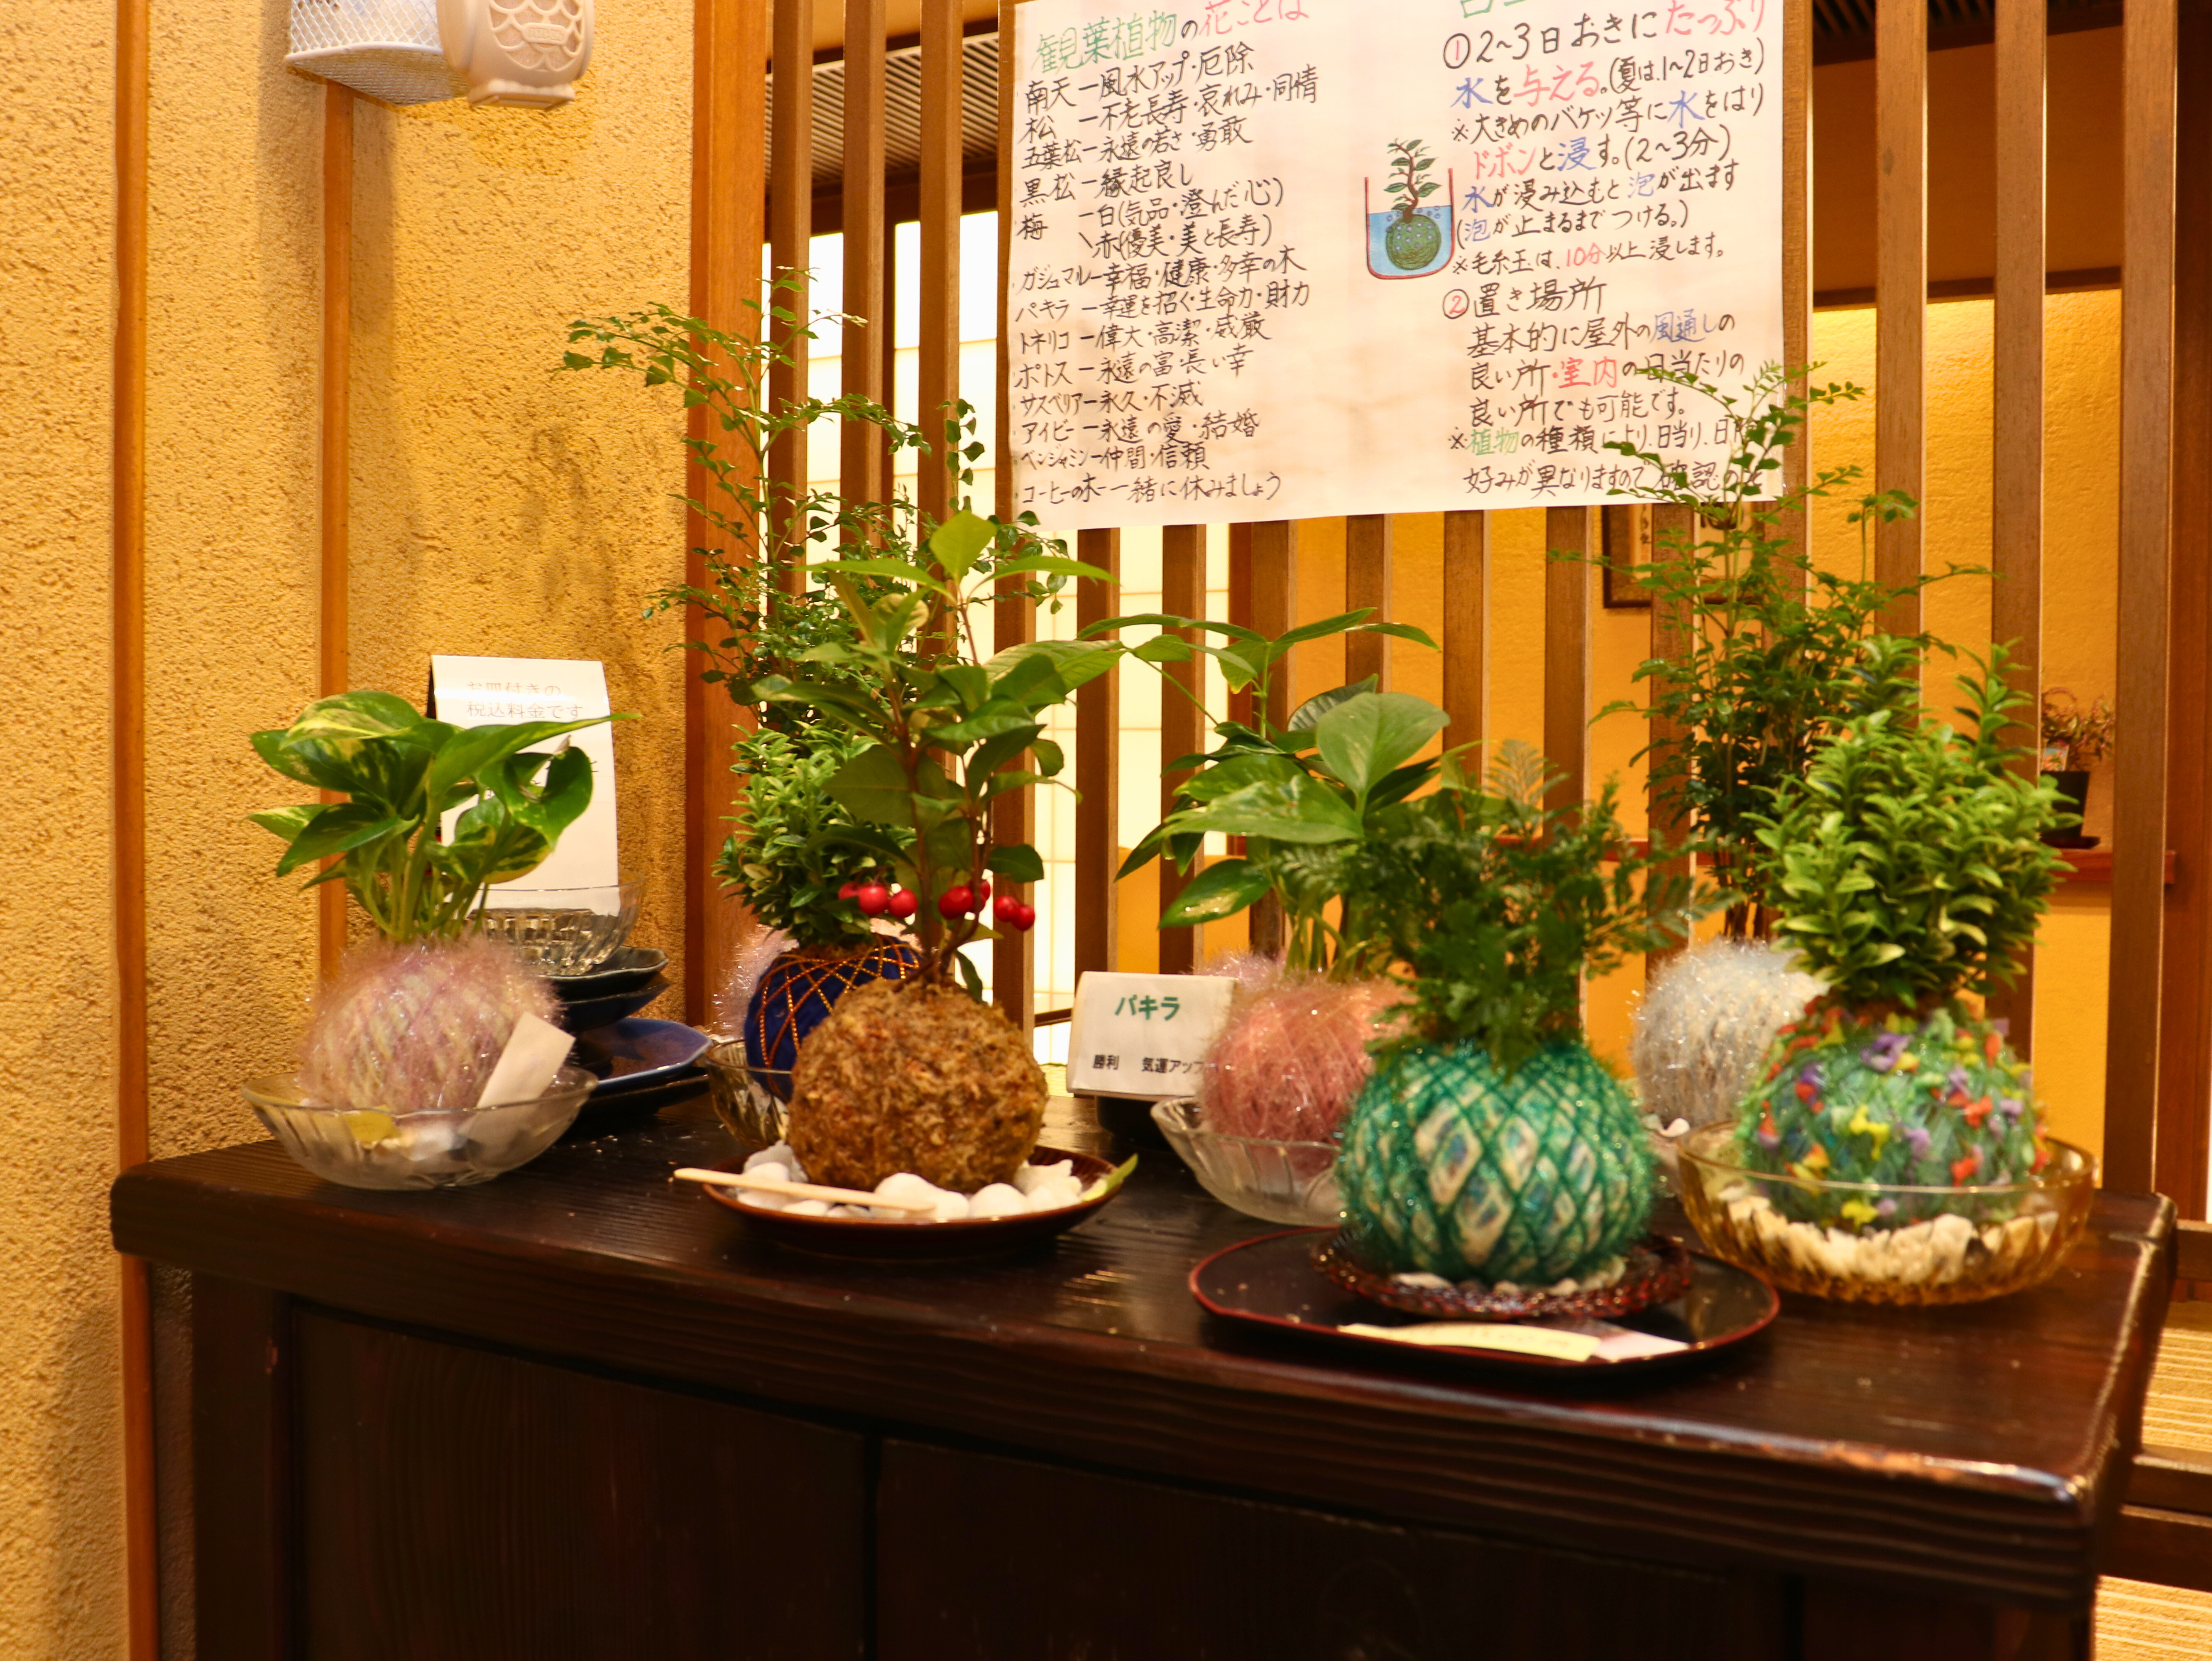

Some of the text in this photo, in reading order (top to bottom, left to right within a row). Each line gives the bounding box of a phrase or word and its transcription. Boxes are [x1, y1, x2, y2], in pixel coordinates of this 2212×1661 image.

[1467, 309, 1735, 358] 基本的に屋外の風通しの
[466, 702, 583, 720] 税込料金です
[1115, 995, 1180, 1021] パキラ
